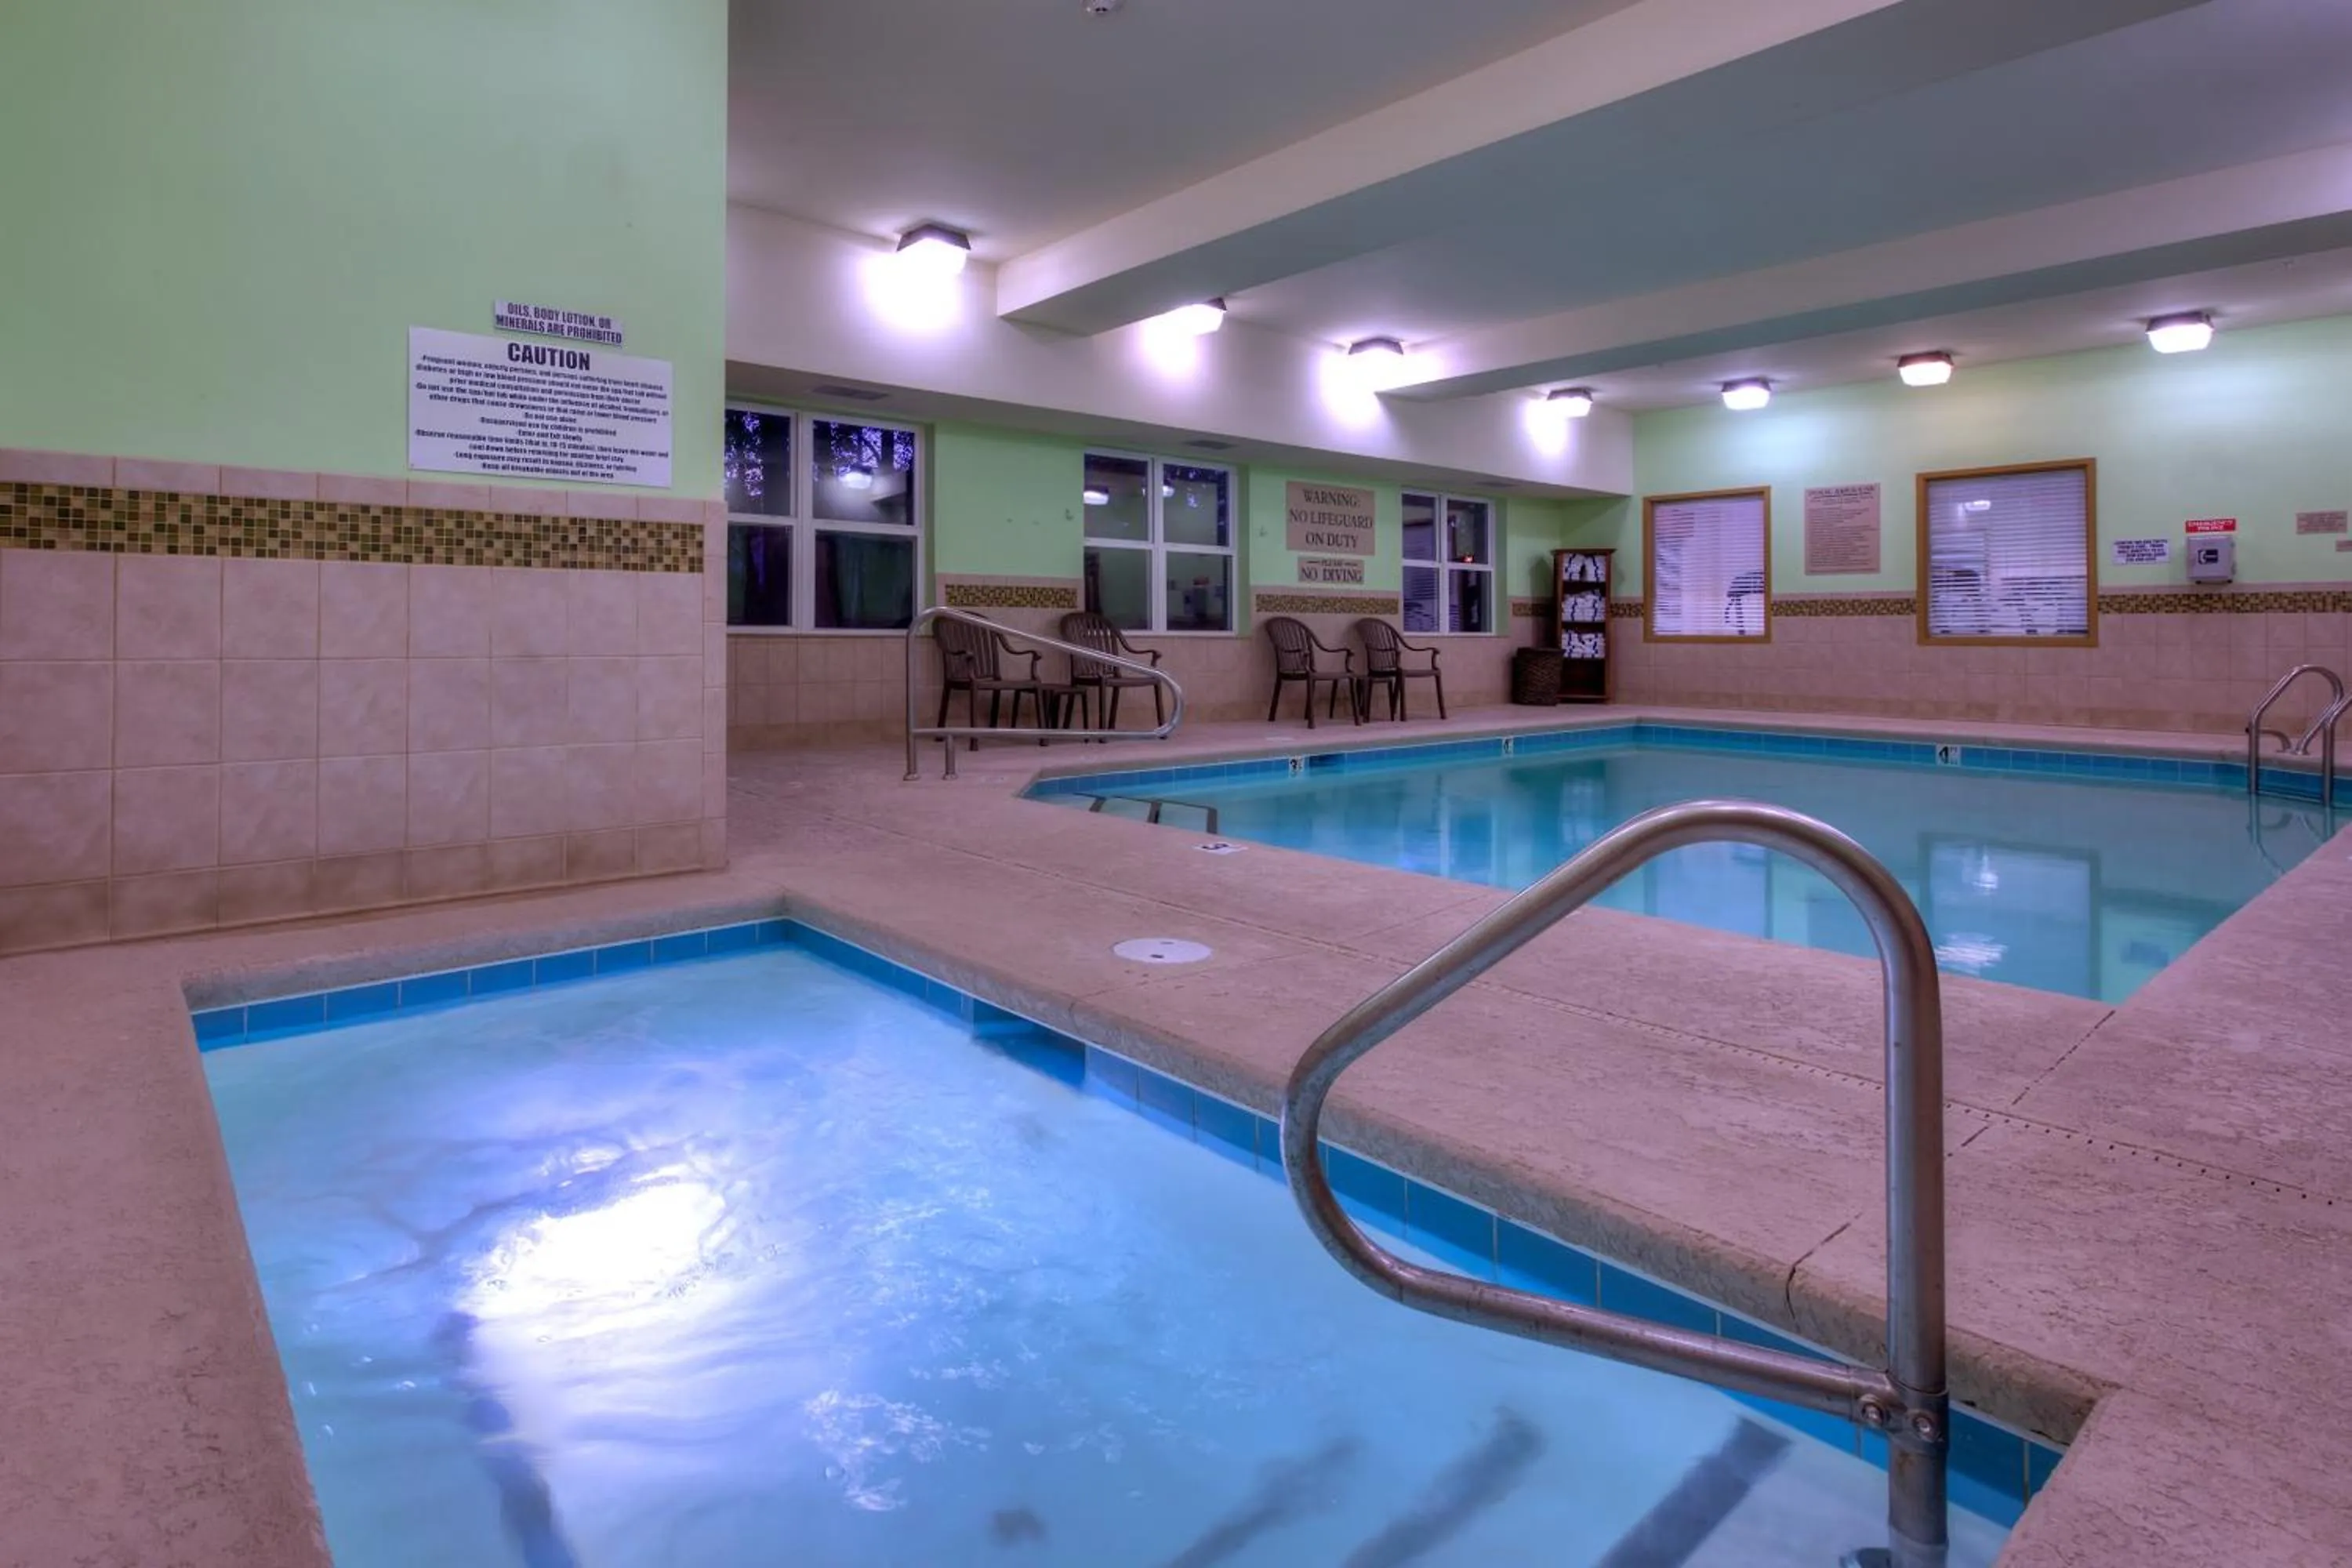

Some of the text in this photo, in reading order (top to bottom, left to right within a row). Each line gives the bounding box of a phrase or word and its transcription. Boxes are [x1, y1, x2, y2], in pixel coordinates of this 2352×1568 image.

[534, 307, 560, 320] BODY
[598, 317, 612, 329] OR
[495, 314, 622, 343] MINERALS ARE PROHIBITED
[507, 342, 590, 370] CAUTION
[1290, 509, 1372, 528] NO LIFEGUARD
[1305, 532, 1359, 548] ON DUTY
[1301, 568, 1362, 583] NO DIVING
